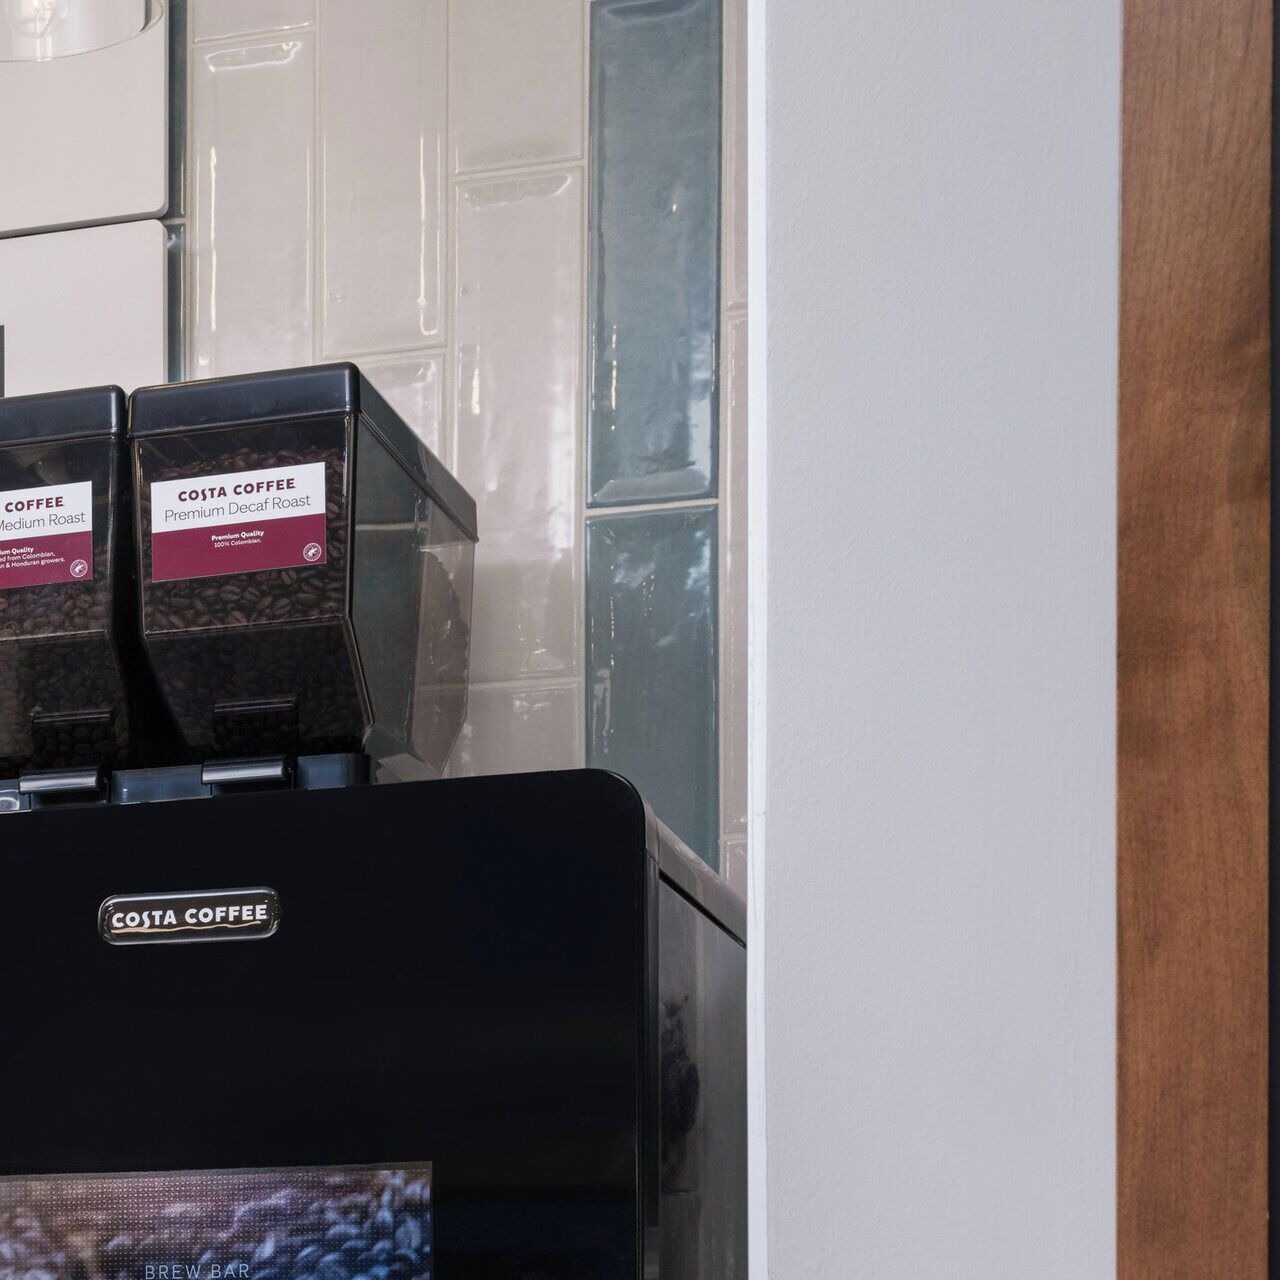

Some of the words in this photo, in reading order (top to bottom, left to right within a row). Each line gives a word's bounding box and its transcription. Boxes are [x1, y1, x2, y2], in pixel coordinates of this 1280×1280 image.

[178, 486, 227, 502] COSTA
[233, 478, 296, 495] COFFEE
[5, 496, 65, 513] COFFEE
[165, 506, 225, 522] Premium
[229, 497, 270, 515] Decaf
[272, 494, 311, 510] Roast
[48, 511, 86, 526] Roast
[211, 533, 240, 541] Premium
[240, 530, 265, 539] Quality
[11, 546, 34, 555] Quality
[11, 560, 40, 568] Honduran
[111, 910, 177, 928] COSTA
[184, 904, 268, 924] COFFEE
[145, 1264, 201, 1280] BREW
[212, 1263, 250, 1279] BAR
